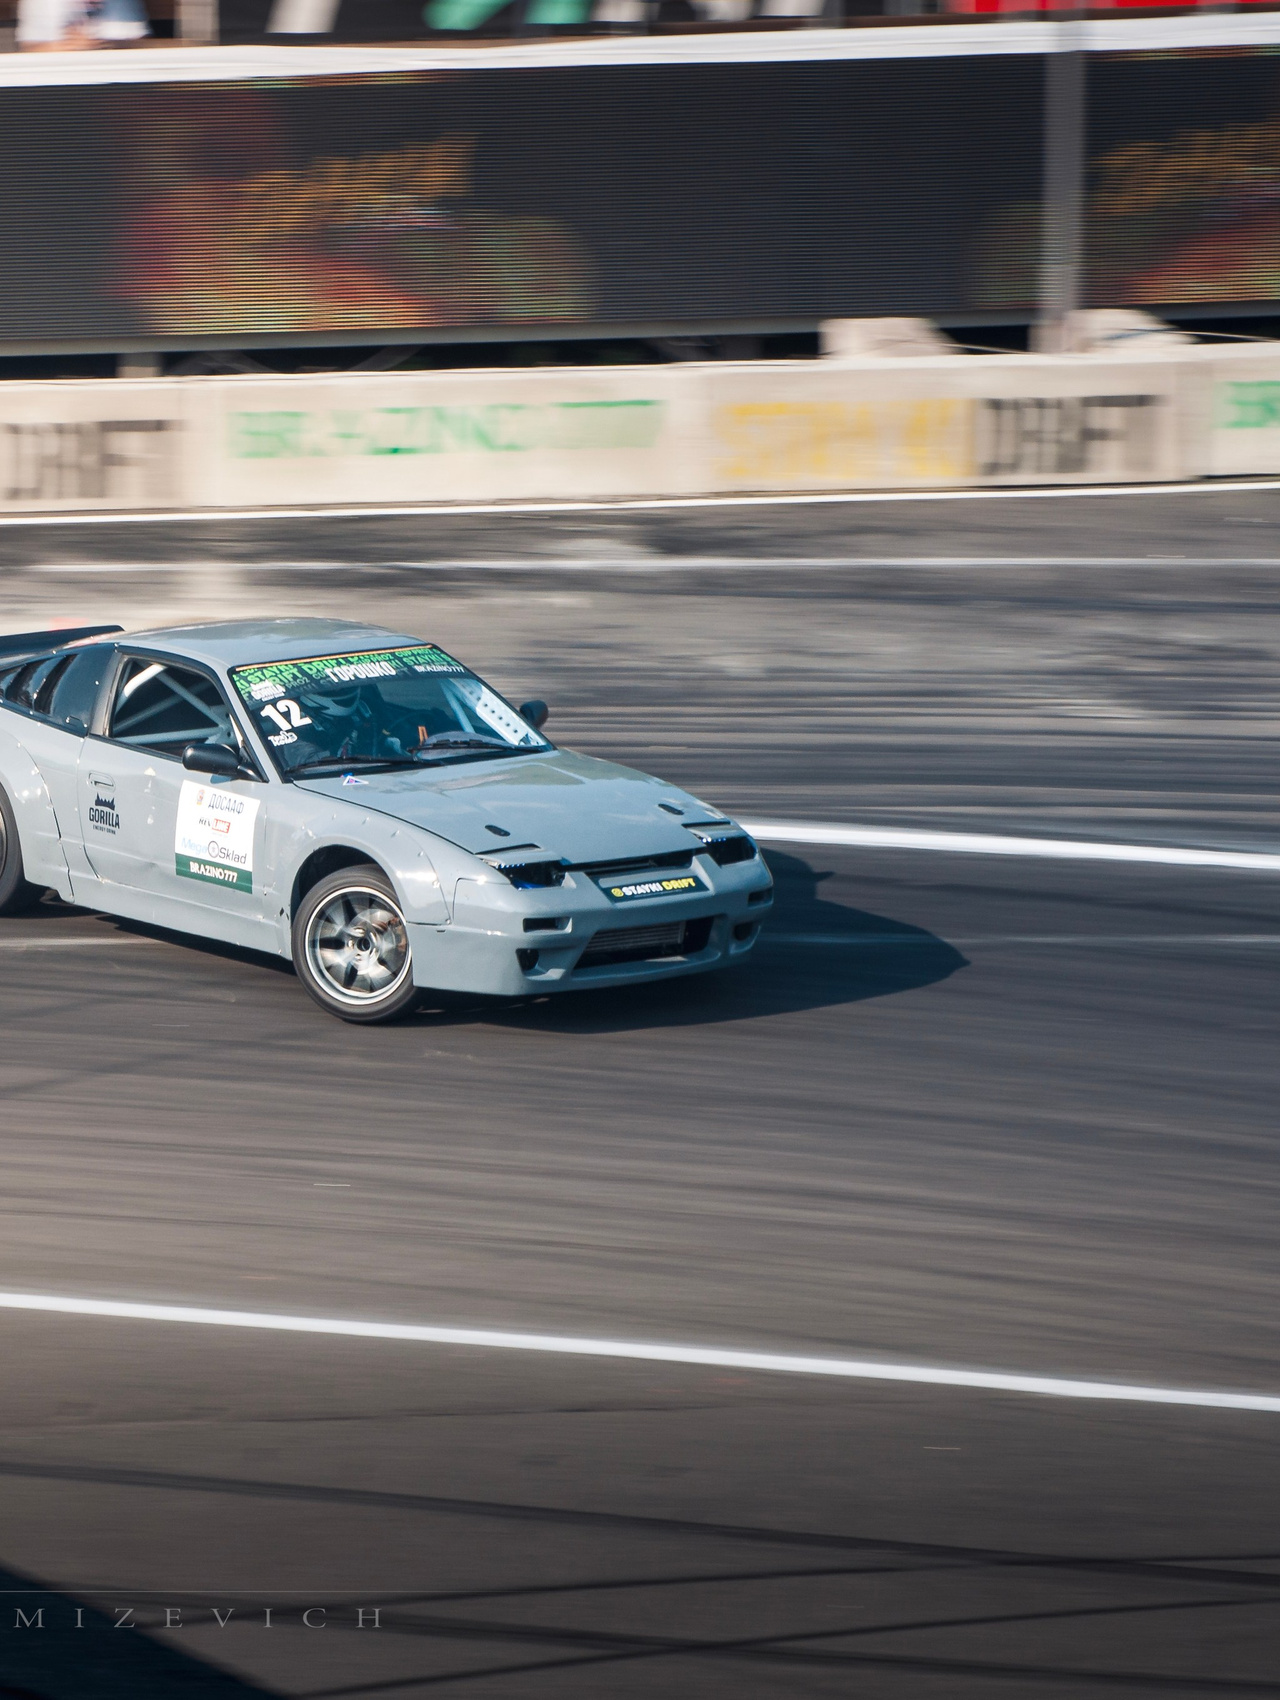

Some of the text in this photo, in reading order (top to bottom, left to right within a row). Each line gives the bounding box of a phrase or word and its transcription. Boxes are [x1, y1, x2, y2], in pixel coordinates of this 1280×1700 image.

[324, 661, 397, 683] ГОРОШКО
[260, 699, 313, 732] 12
[208, 793, 245, 815] ДОСААФ
[88, 807, 121, 830] GORILLA
[218, 846, 248, 865] Sklad
[189, 861, 238, 884] BRAZINO777
[661, 878, 696, 891] DRIFT
